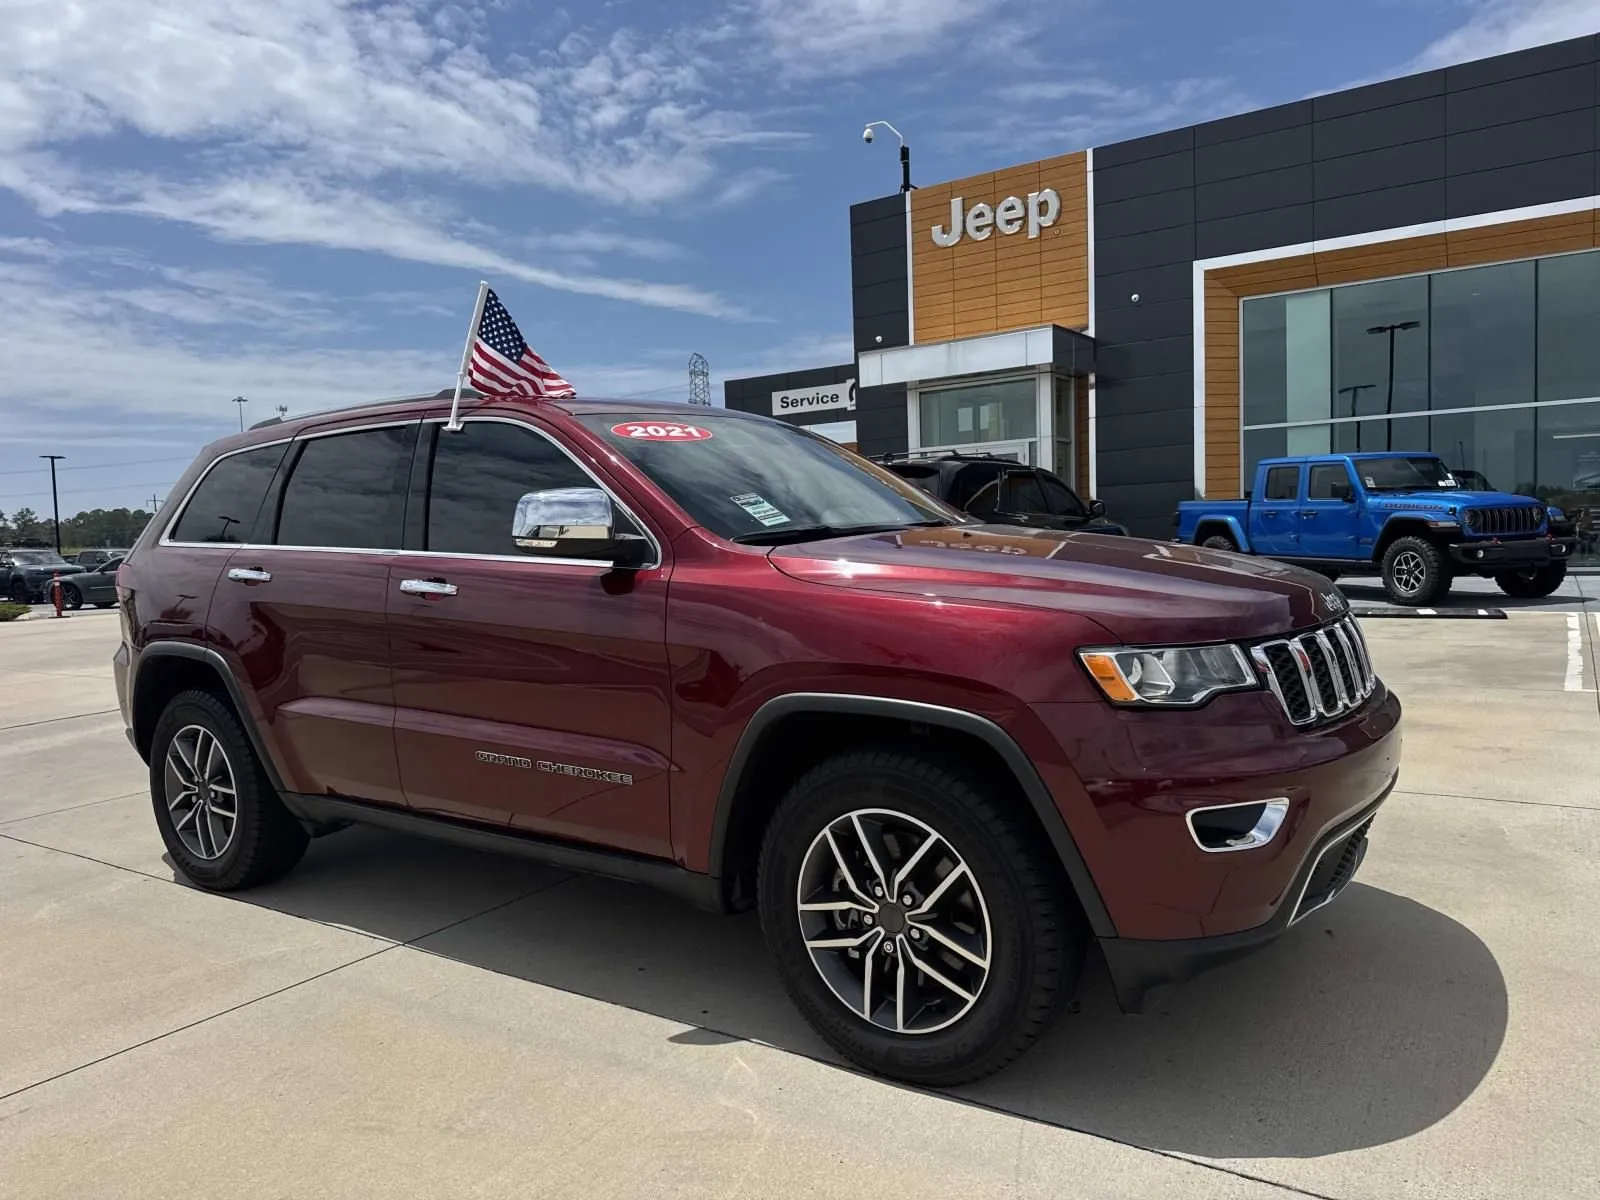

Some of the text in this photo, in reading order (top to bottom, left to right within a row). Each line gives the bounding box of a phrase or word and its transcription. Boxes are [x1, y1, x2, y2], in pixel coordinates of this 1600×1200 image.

[931, 188, 1060, 248] Jeep
[780, 392, 840, 409] Service
[626, 425, 702, 438] 2021
[475, 750, 633, 786] GRAND CHEROKEE
